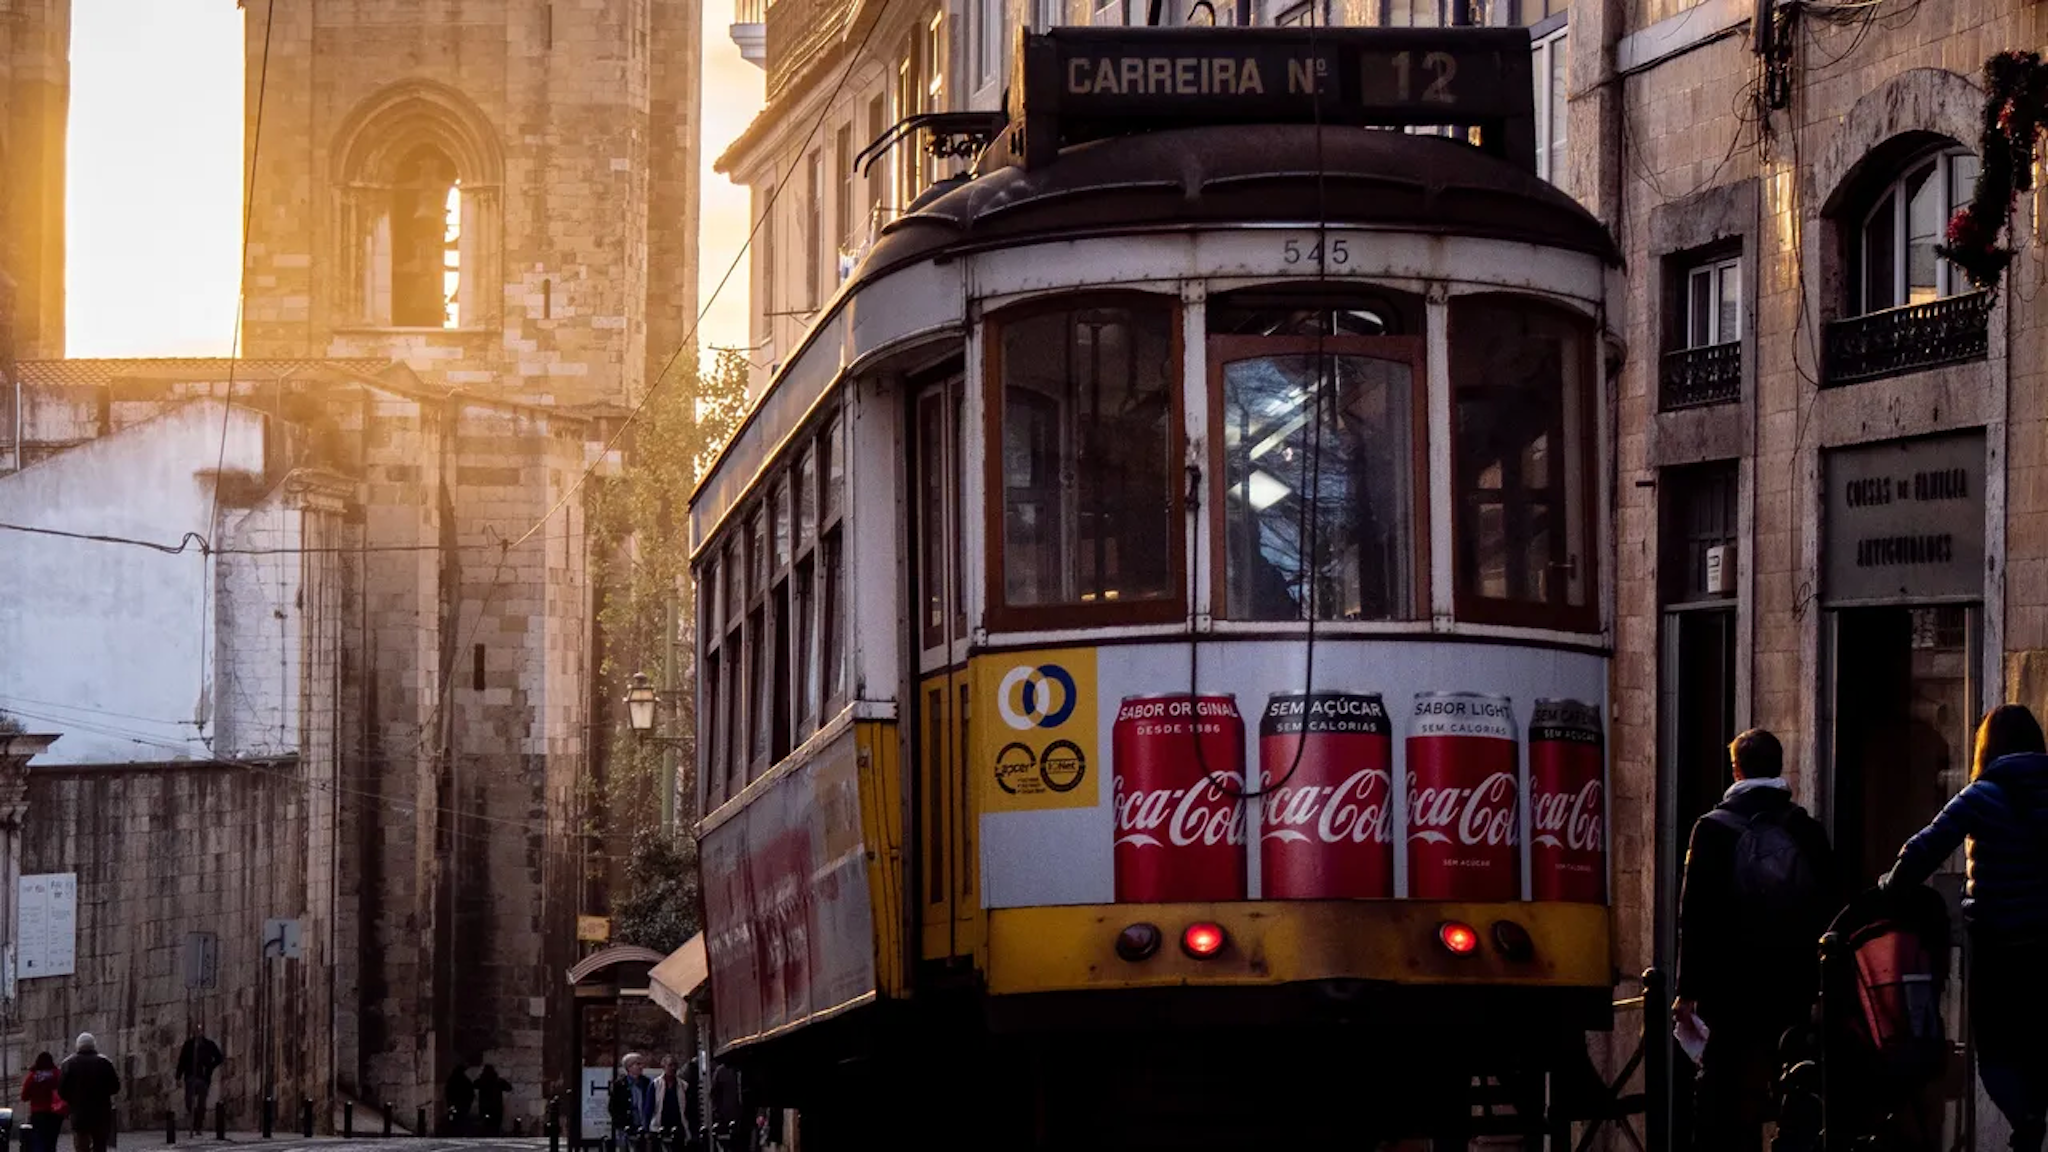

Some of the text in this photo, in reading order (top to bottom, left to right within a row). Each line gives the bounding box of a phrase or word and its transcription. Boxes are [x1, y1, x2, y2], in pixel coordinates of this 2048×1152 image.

[1067, 57, 1264, 94] CARREIRA
[1391, 50, 1459, 103] 12
[1284, 239, 1349, 266] 545
[1119, 701, 1238, 721] SABOR ORGINAL
[1269, 697, 1382, 718] SEM AÇÚCAR
[1414, 702, 1510, 719] SABOR LIGHT
[1136, 723, 1182, 735] DESDE
[1276, 720, 1378, 732] SEM CALORIAS
[1422, 724, 1507, 735] SEM CALORIAS
[1544, 728, 1562, 739] SEM
